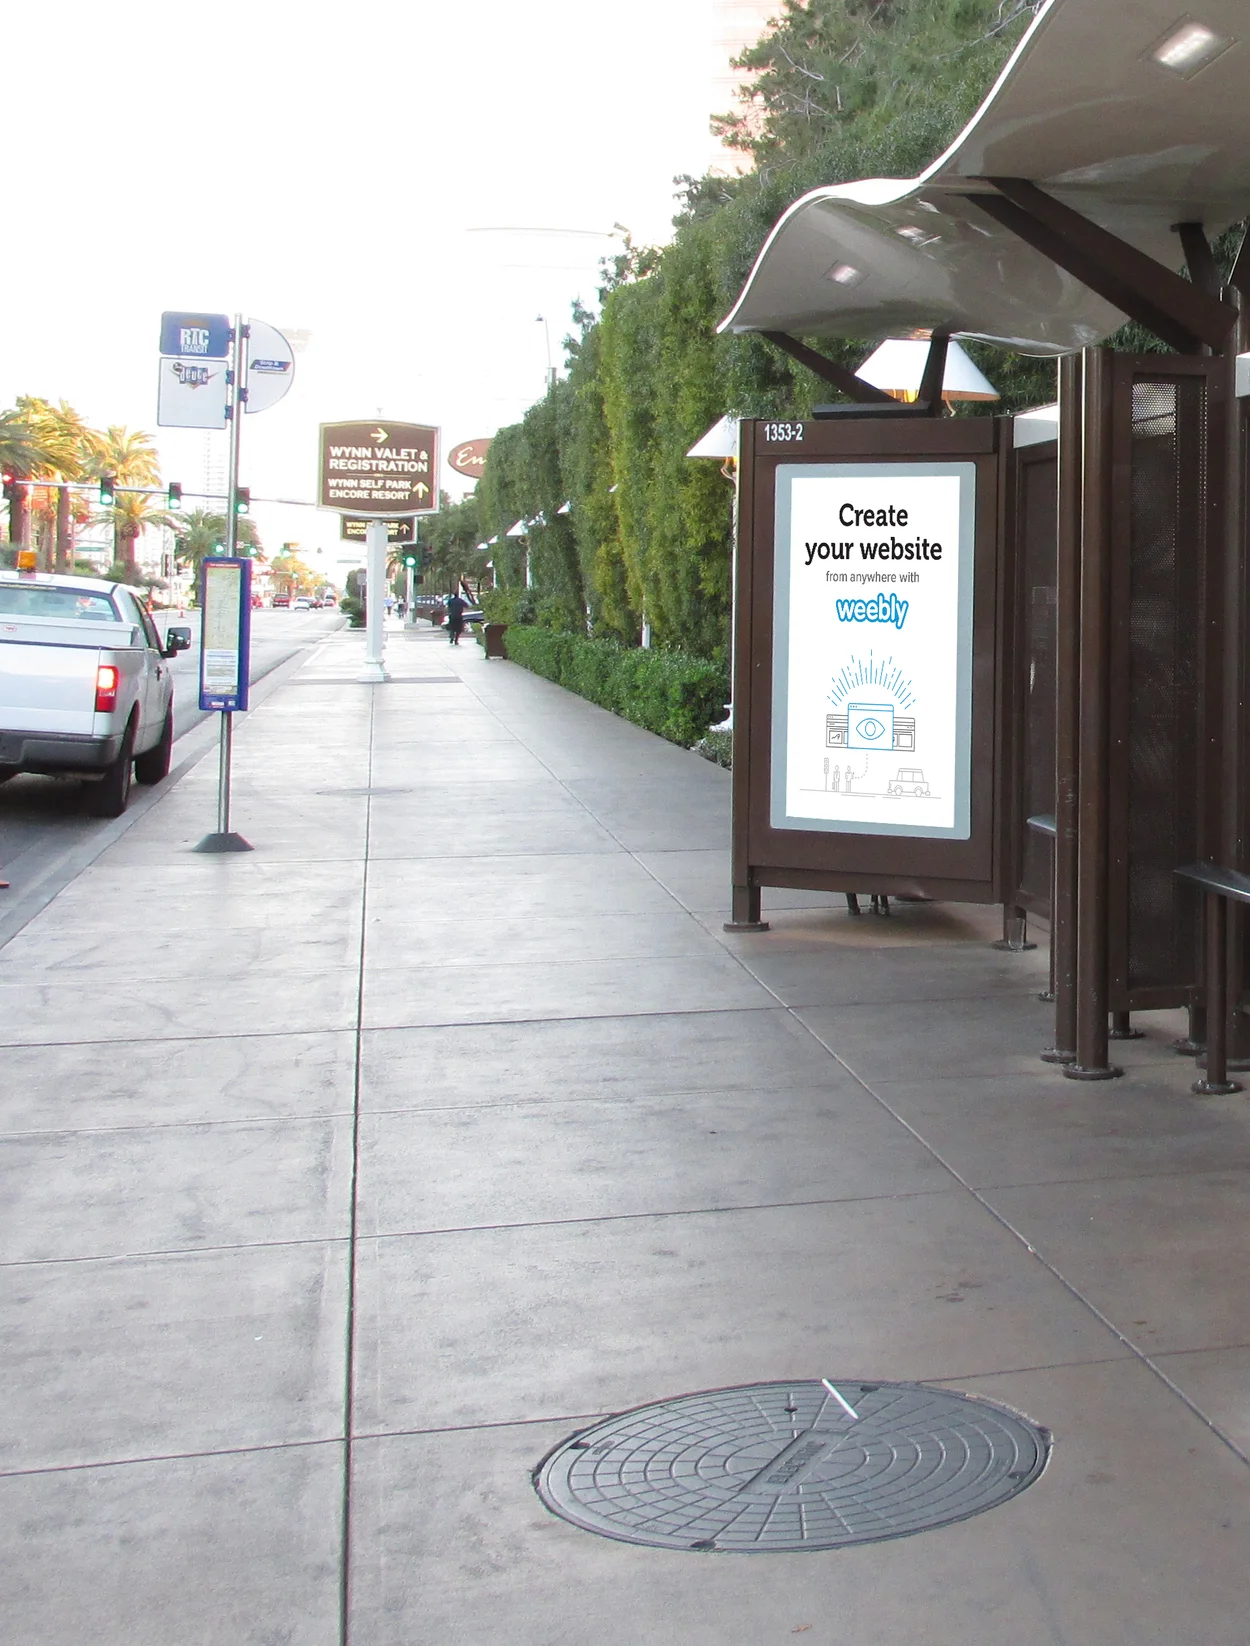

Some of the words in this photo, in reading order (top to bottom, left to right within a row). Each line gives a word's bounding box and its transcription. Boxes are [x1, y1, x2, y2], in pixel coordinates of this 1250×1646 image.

[180, 327, 209, 346] RTC
[180, 344, 208, 354] TRANSIT
[764, 423, 803, 442] 1353-2
[329, 446, 372, 458] WYNN
[374, 447, 418, 460] VALET
[419, 450, 429, 460] &
[456, 446, 488, 467] En
[329, 458, 428, 473] REGISTRATION
[328, 478, 358, 488] WYNN
[359, 479, 385, 489] SELF
[385, 480, 412, 490] PARK
[329, 489, 371, 499] ENCORE
[371, 490, 411, 500] RESORT
[838, 502, 909, 527] Create
[804, 541, 855, 566] your
[859, 536, 943, 561] website
[825, 570, 848, 583] from
[849, 571, 897, 585] anywhere
[899, 571, 920, 583] with
[835, 592, 909, 630] weebly
